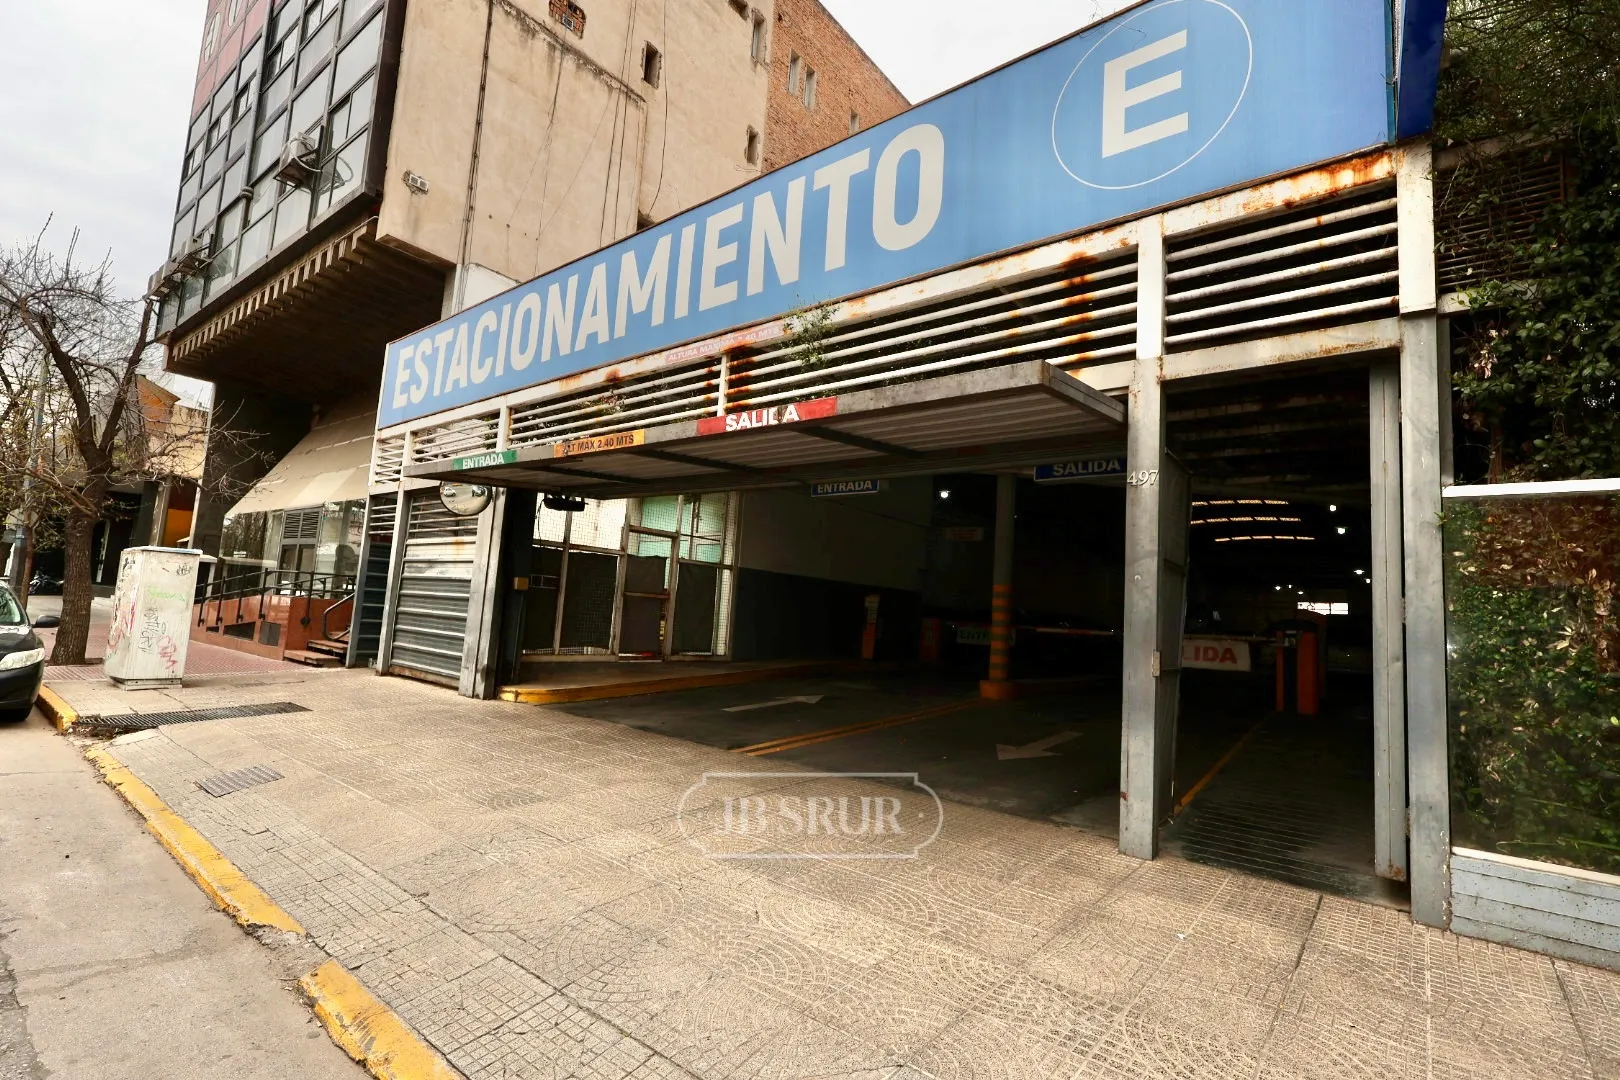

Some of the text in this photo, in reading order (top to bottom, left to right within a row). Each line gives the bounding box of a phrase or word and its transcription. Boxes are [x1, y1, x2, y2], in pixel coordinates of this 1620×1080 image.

[1101, 29, 1189, 159] E
[392, 123, 945, 409] ESTACIONAMIENTO
[668, 349, 697, 362] ALTURA
[759, 326, 780, 340] MTS
[577, 440, 595, 452] MAX
[616, 434, 634, 446] MTS
[462, 452, 505, 469] ENTRADA
[1052, 458, 1121, 476] SALIDA
[817, 479, 873, 494] ENTRADA
[1127, 469, 1158, 486] 497
